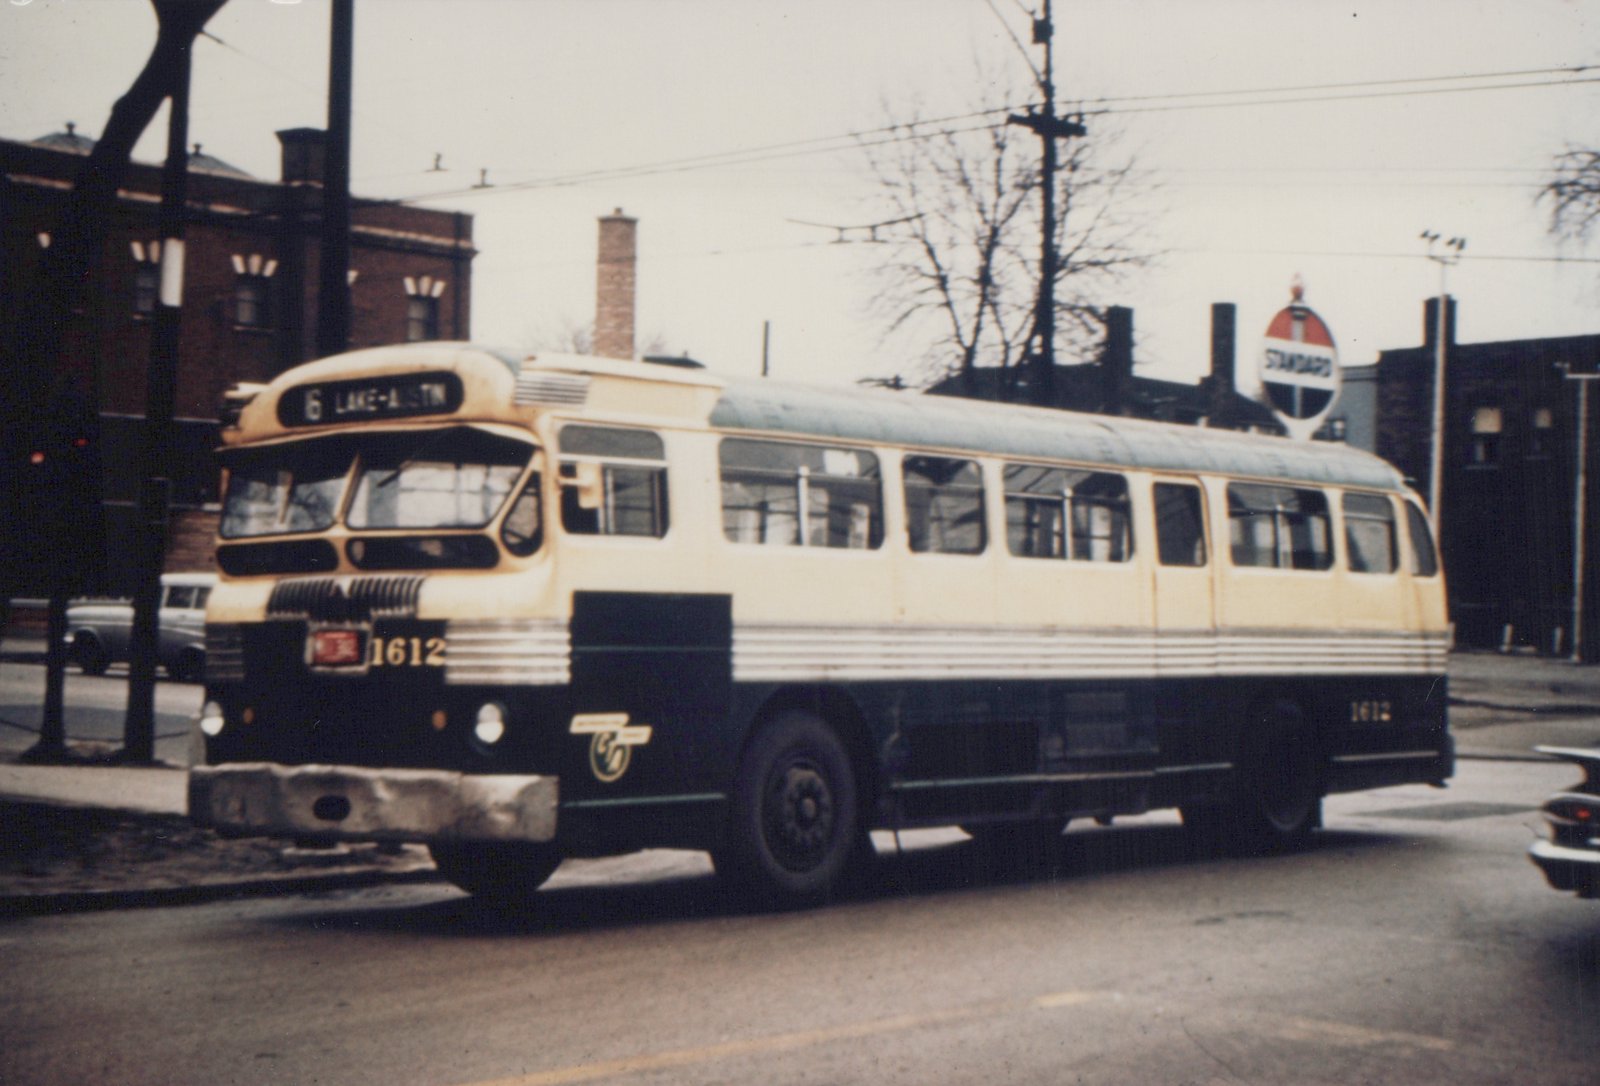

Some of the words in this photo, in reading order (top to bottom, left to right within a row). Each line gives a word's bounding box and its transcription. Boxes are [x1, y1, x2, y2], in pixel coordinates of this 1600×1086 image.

[1265, 348, 1332, 378] STANDARD
[304, 388, 322, 421] 6
[336, 383, 447, 414] LAKE-ATIN
[372, 637, 447, 666] 1612
[1351, 701, 1392, 721] 1612
